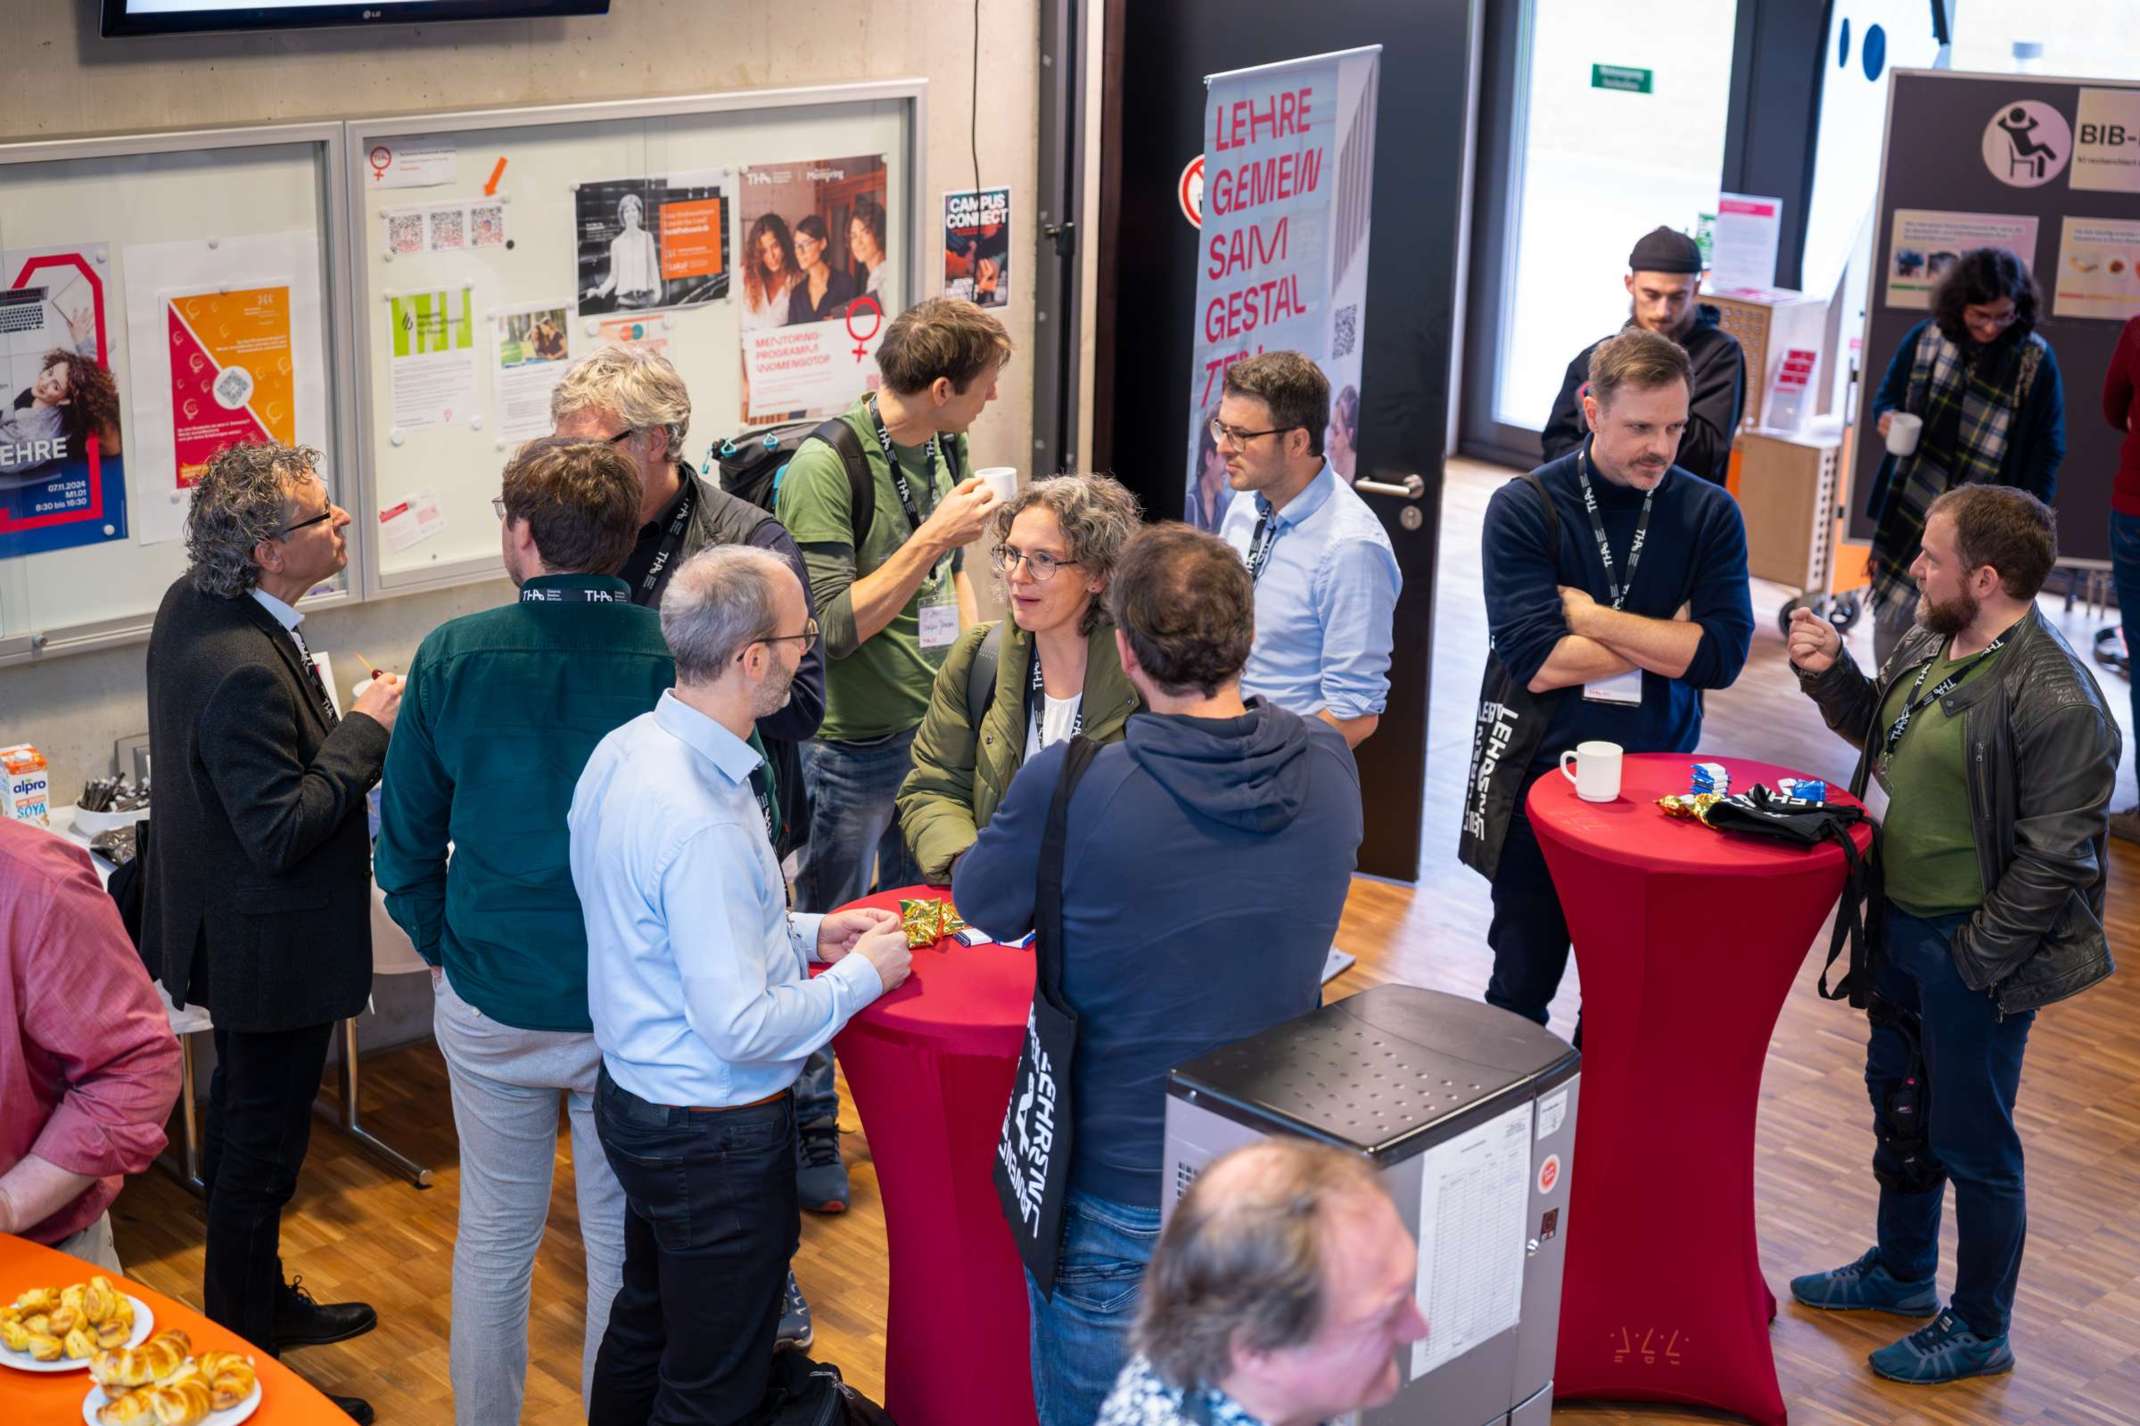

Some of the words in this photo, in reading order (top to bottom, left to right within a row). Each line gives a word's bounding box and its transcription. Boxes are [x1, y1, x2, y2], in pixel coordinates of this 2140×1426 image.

[1216, 87, 1312, 152] LEHRE
[2080, 124, 2140, 146] BIB-
[1212, 147, 1322, 217] GEMEIN
[1208, 216, 1288, 282] SAM
[1205, 273, 1307, 345] GESTAL
[878, 425, 891, 451] THA
[896, 477, 910, 502] THA
[1584, 486, 1598, 514] THA
[1630, 528, 1647, 552] THA
[649, 551, 670, 575] THA
[1600, 542, 1613, 568] THA
[523, 588, 545, 602] THA
[584, 589, 614, 602] THA
[1032, 661, 1044, 692] THA
[1933, 678, 1957, 697] THA
[13, 780, 46, 795] alpro
[17, 803, 47, 819] SOYA
